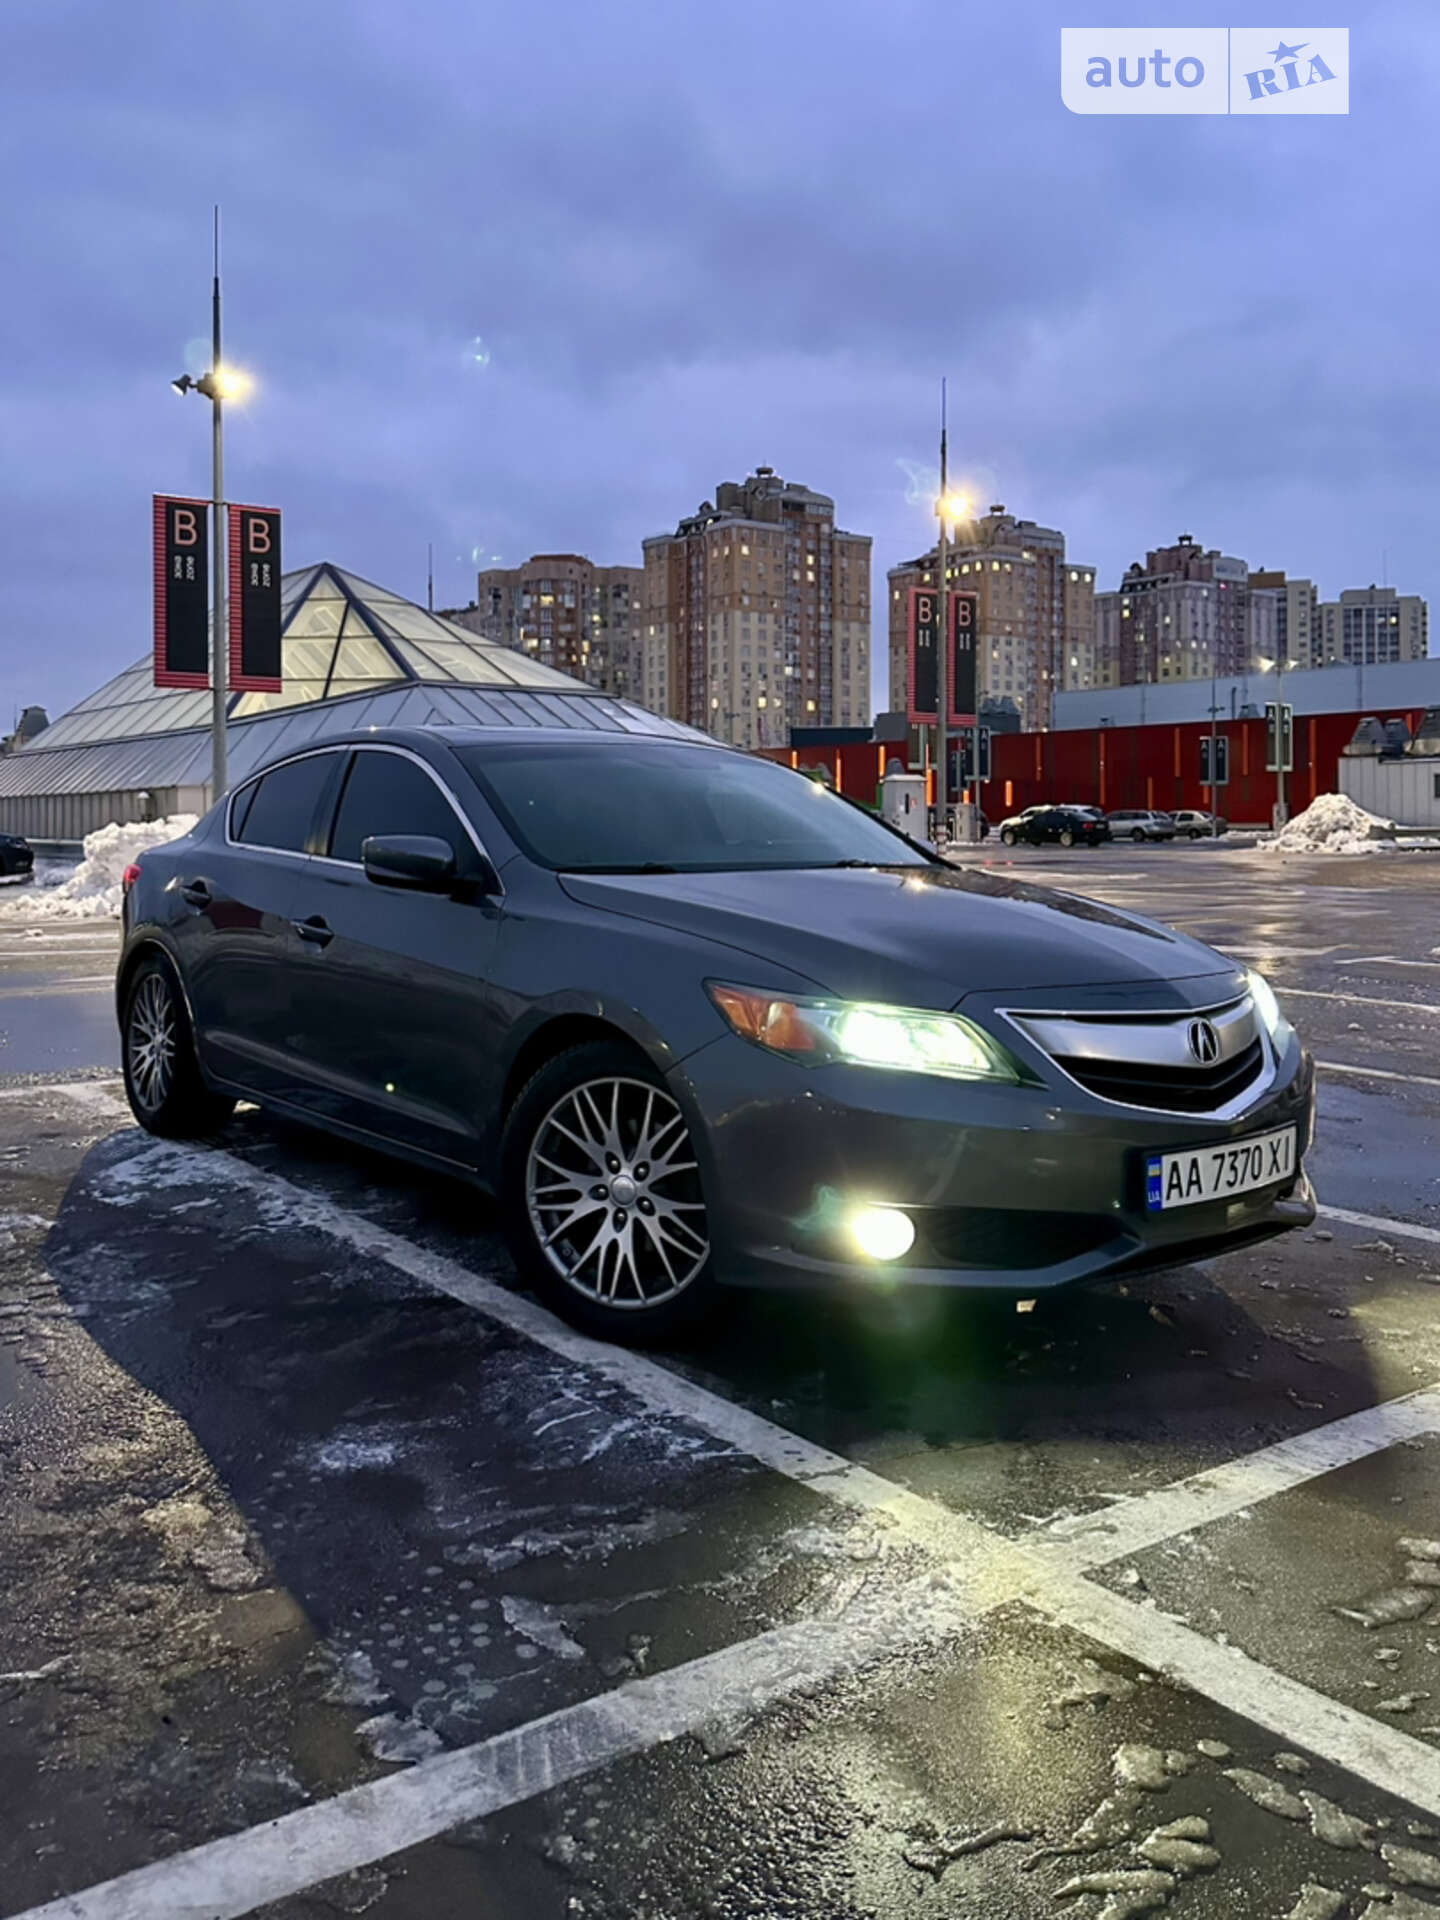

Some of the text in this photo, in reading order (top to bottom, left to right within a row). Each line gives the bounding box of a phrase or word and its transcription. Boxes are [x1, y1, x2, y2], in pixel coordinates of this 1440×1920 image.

[174, 509, 198, 546] B
[249, 518, 271, 554] B
[919, 597, 932, 624] B
[959, 601, 971, 627] B
[1166, 1136, 1290, 1201] AA 7370 XI
